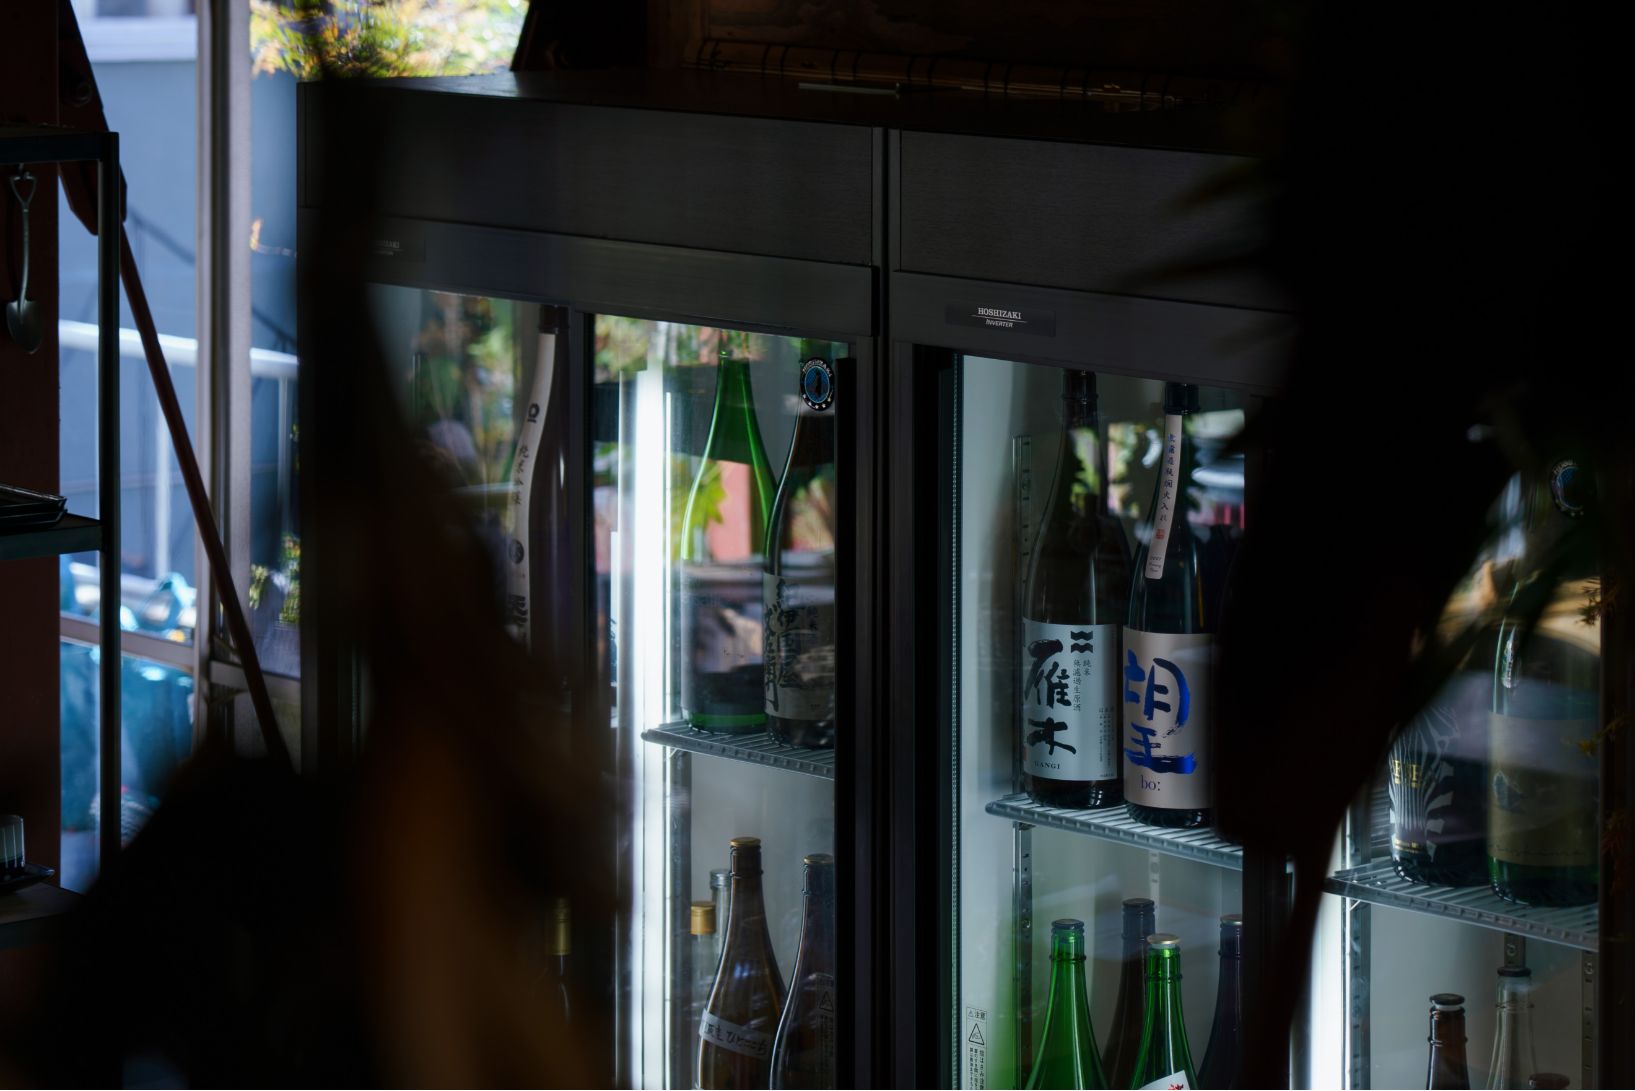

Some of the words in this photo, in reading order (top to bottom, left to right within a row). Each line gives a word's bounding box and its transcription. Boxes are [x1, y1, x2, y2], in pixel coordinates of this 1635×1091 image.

[978, 307, 1021, 319] HOSHIZAKI
[985, 319, 1014, 328] INVERTER
[1025, 639, 1077, 755] 雁木
[1124, 649, 1197, 775] 望
